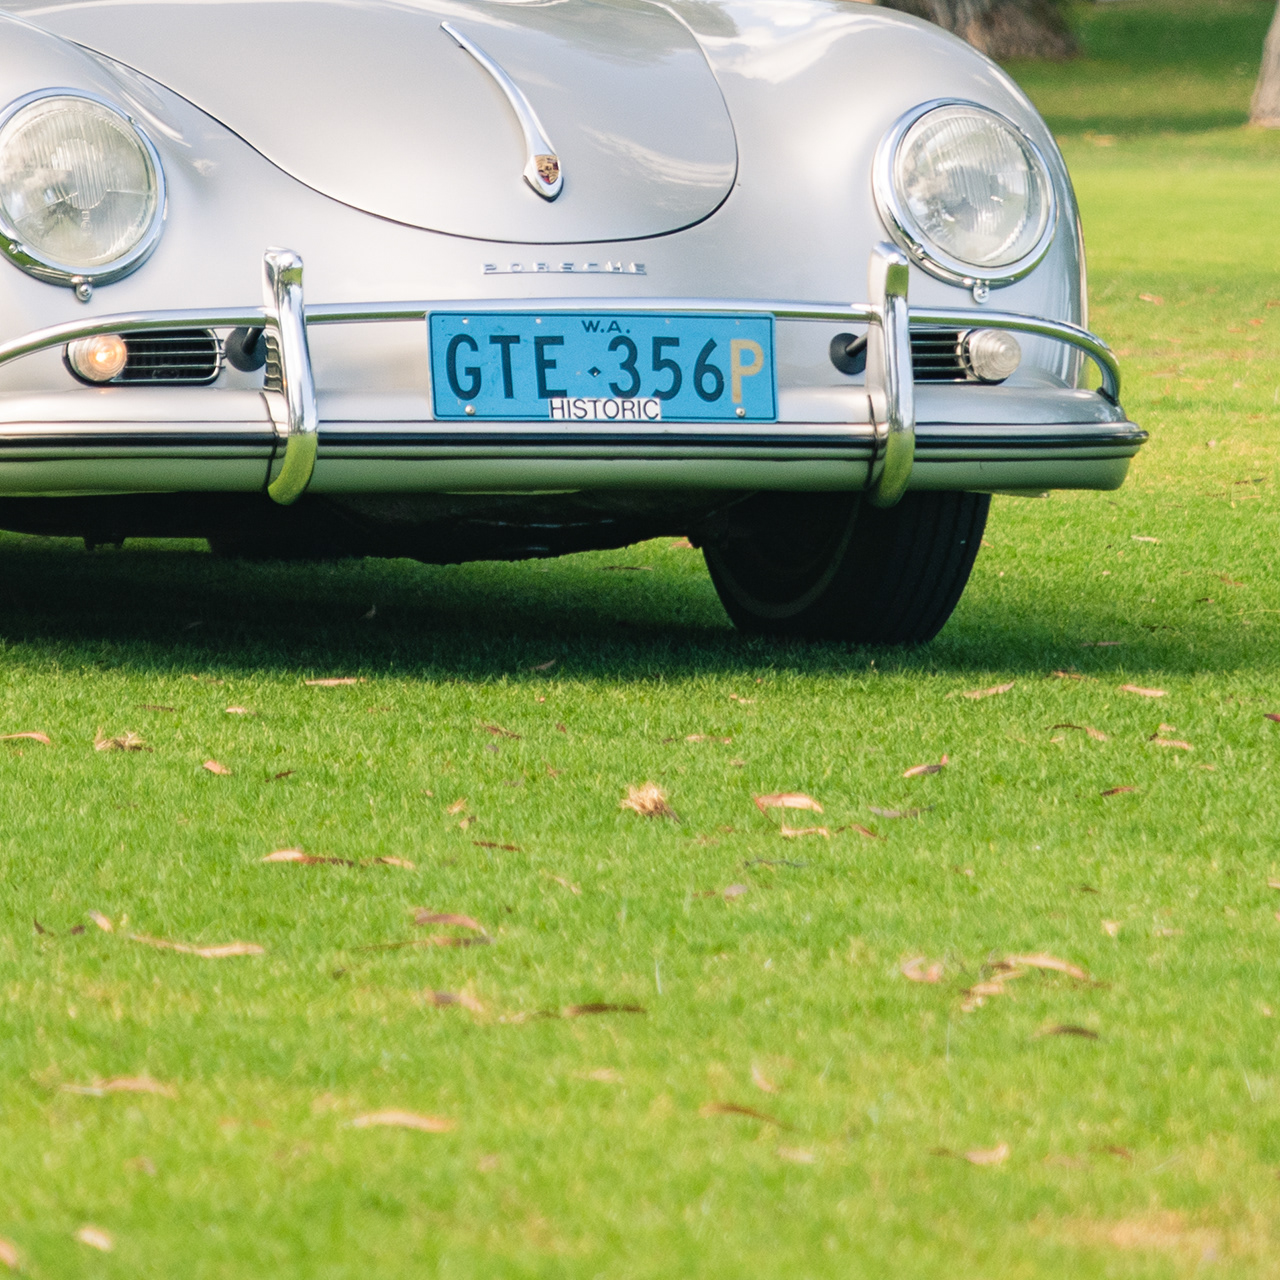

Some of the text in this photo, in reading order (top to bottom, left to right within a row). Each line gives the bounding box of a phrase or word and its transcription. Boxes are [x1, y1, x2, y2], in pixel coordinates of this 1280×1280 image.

[480, 261, 646, 273] PORSCHE
[581, 320, 631, 334] W.A.
[445, 333, 568, 400] GTE
[549, 398, 660, 419] HISTORIC
